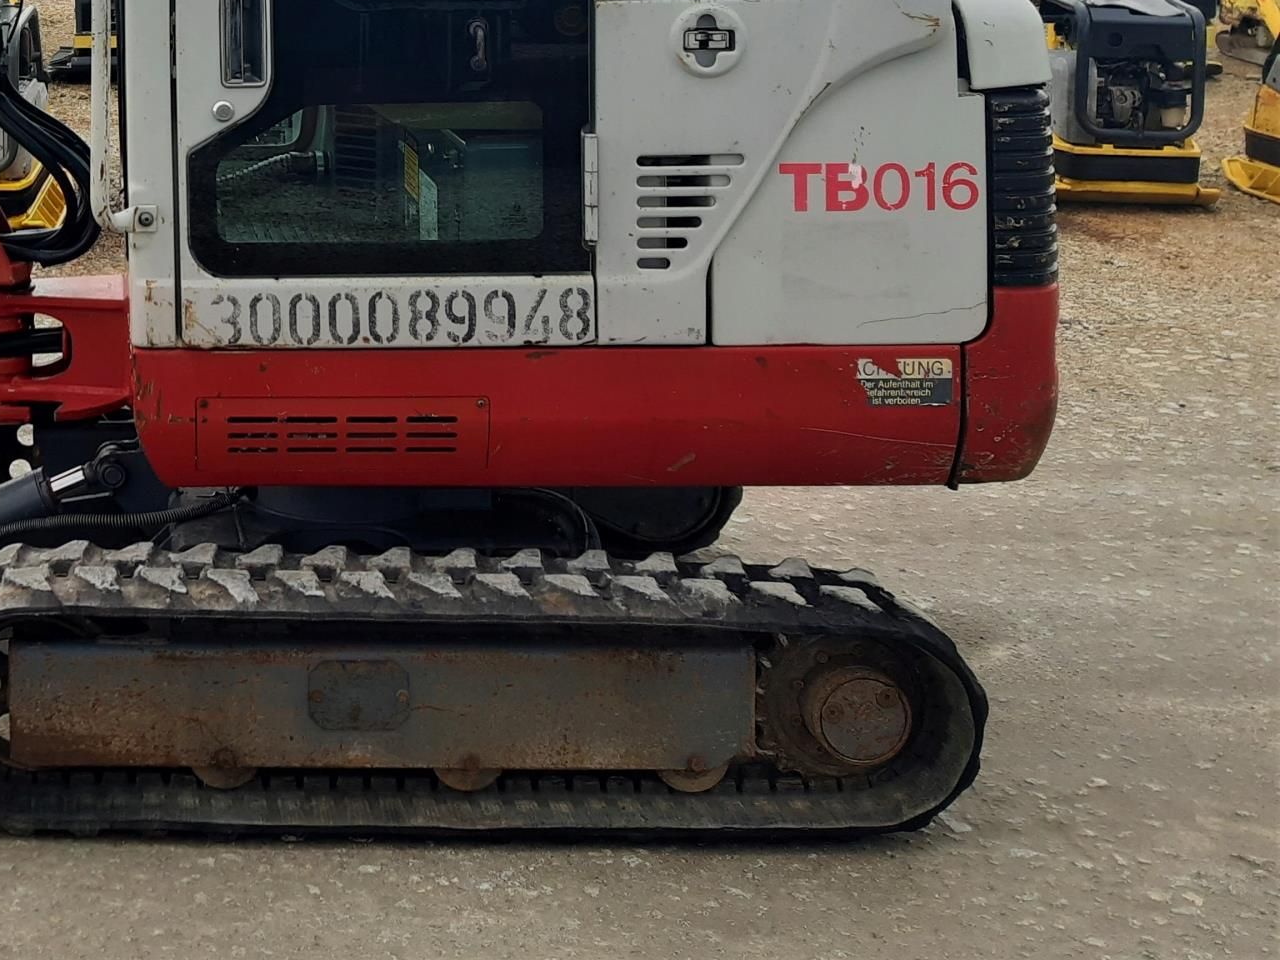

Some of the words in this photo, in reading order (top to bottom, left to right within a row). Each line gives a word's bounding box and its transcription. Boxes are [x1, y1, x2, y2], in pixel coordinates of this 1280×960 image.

[778, 161, 980, 212] TB016
[211, 286, 592, 346] 3000089948
[878, 380, 921, 389] Aufenthalt
[922, 380, 934, 388] im
[872, 397, 882, 405] ist
[885, 397, 921, 406] verboten
